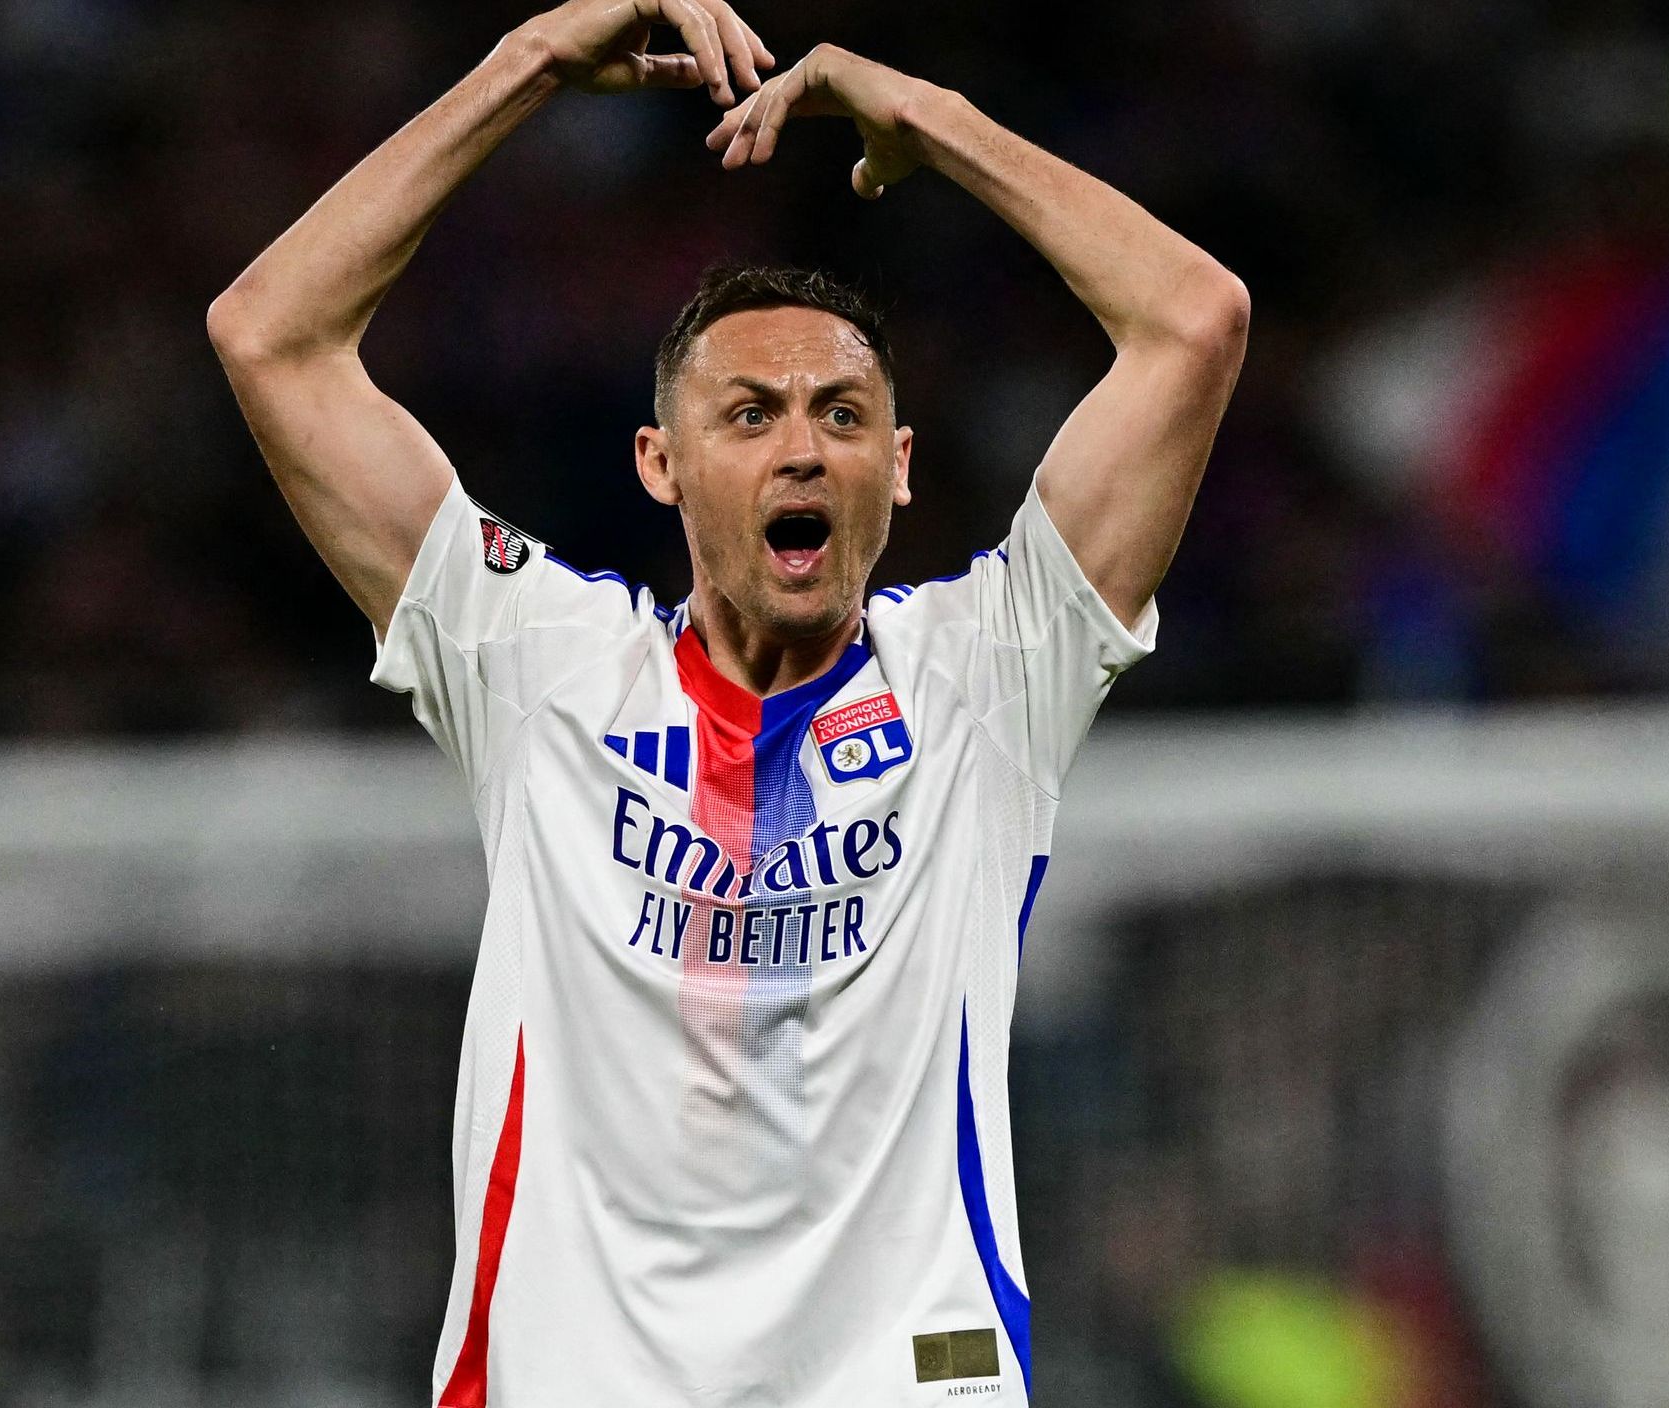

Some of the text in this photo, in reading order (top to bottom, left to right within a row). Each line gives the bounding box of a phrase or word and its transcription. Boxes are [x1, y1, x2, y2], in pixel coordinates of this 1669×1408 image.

[505, 535, 524, 569] HOMO
[818, 698, 890, 729] OLYMPIQUE
[820, 708, 892, 740] LYONNAIS
[831, 728, 905, 772] OL
[628, 891, 868, 965] FLY BETTER
[947, 1384, 1001, 1396] AEROREADY
